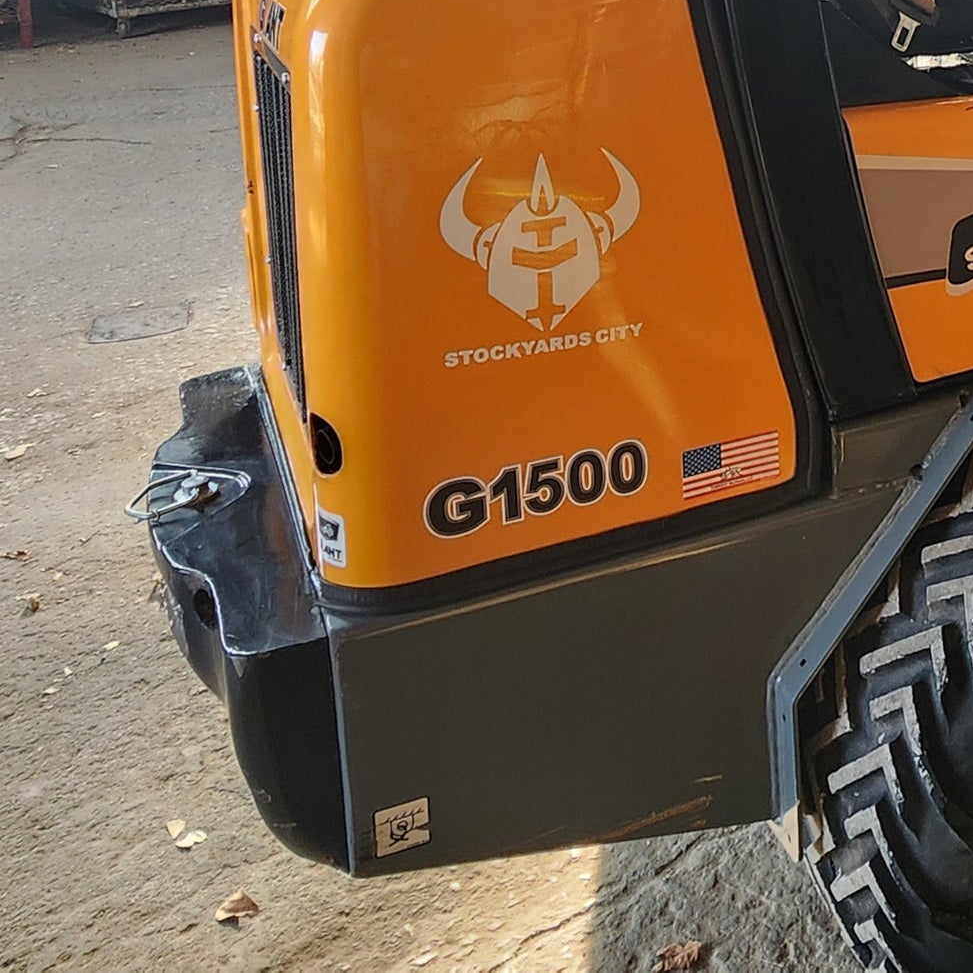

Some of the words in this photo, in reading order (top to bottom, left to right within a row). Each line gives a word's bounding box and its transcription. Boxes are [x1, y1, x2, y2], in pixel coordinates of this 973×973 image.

[444, 331, 593, 369] STOCKYARDS
[594, 322, 644, 345] CITY
[422, 438, 648, 539] G1500
